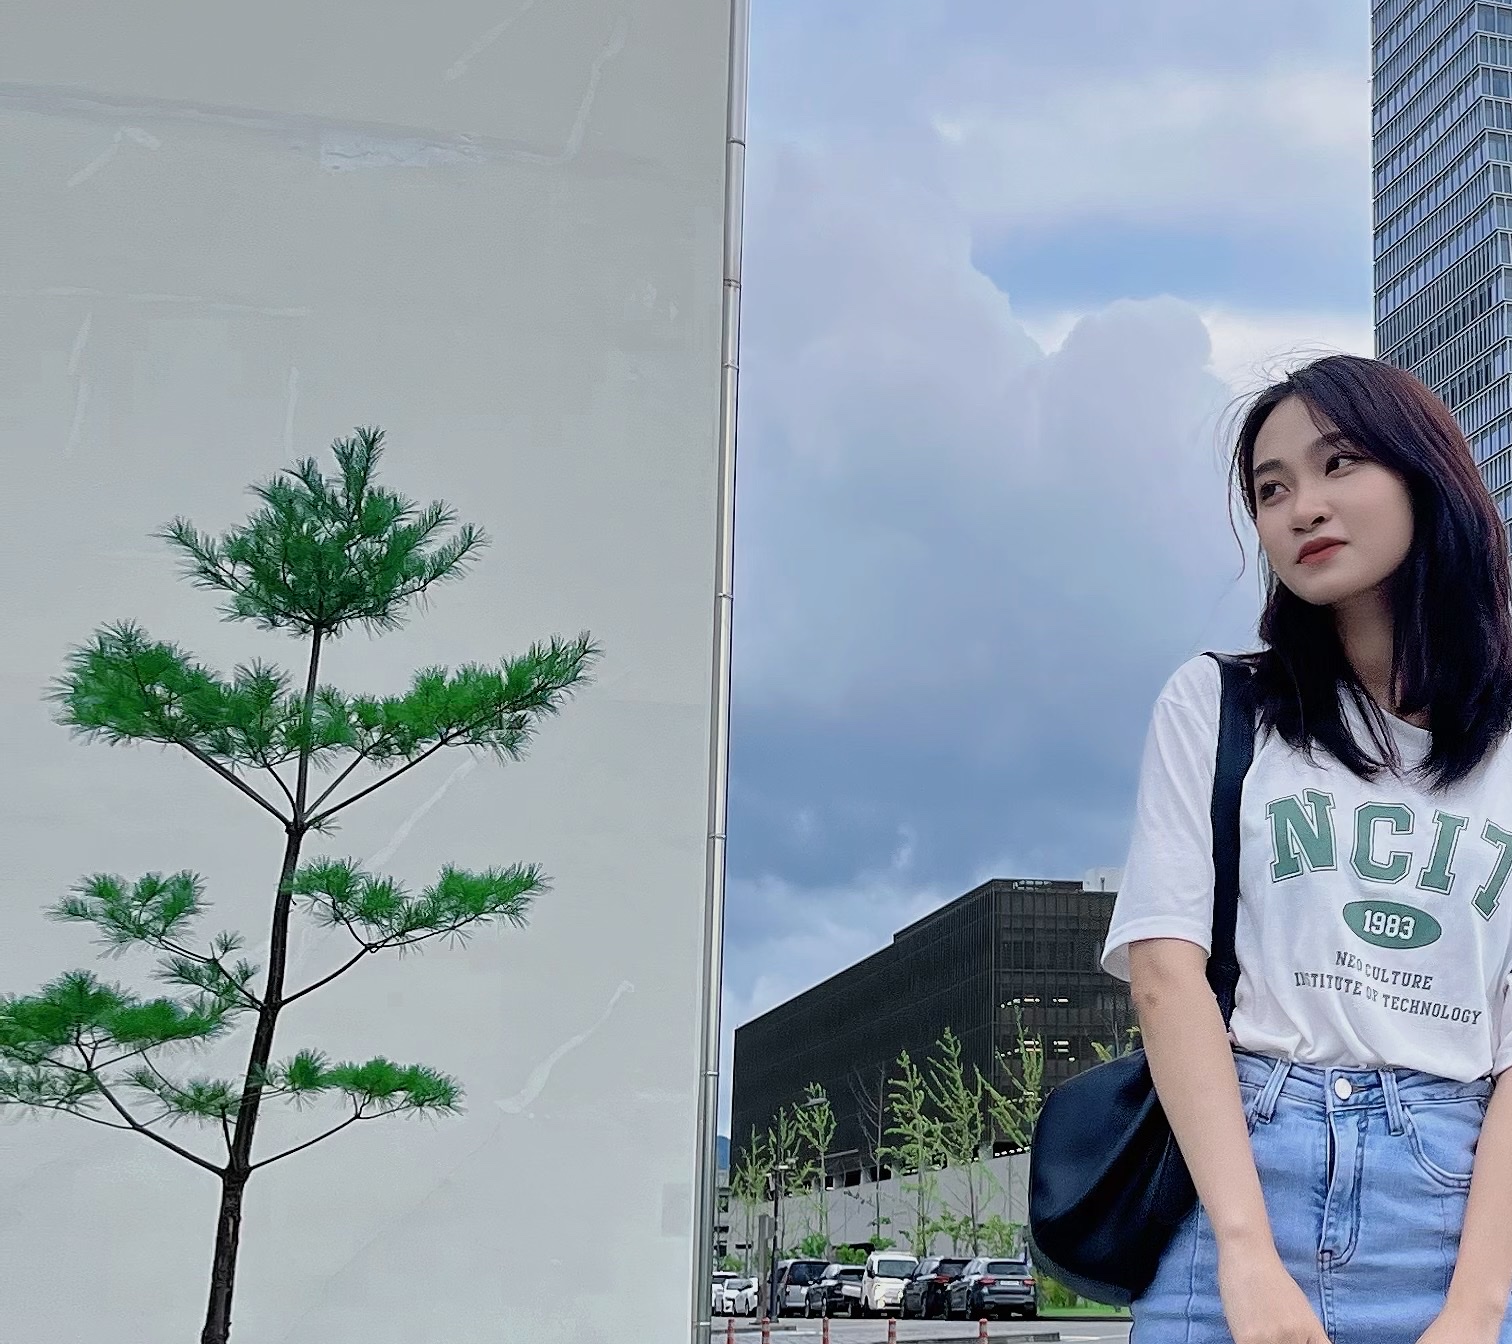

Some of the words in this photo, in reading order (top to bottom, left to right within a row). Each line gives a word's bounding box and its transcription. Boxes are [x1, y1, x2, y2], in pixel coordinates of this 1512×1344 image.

[1362, 909, 1417, 941] 1983
[1335, 950, 1363, 972] NEO
[1365, 963, 1434, 991] CULTURE
[1382, 993, 1483, 1026] TECHNOLOGY
